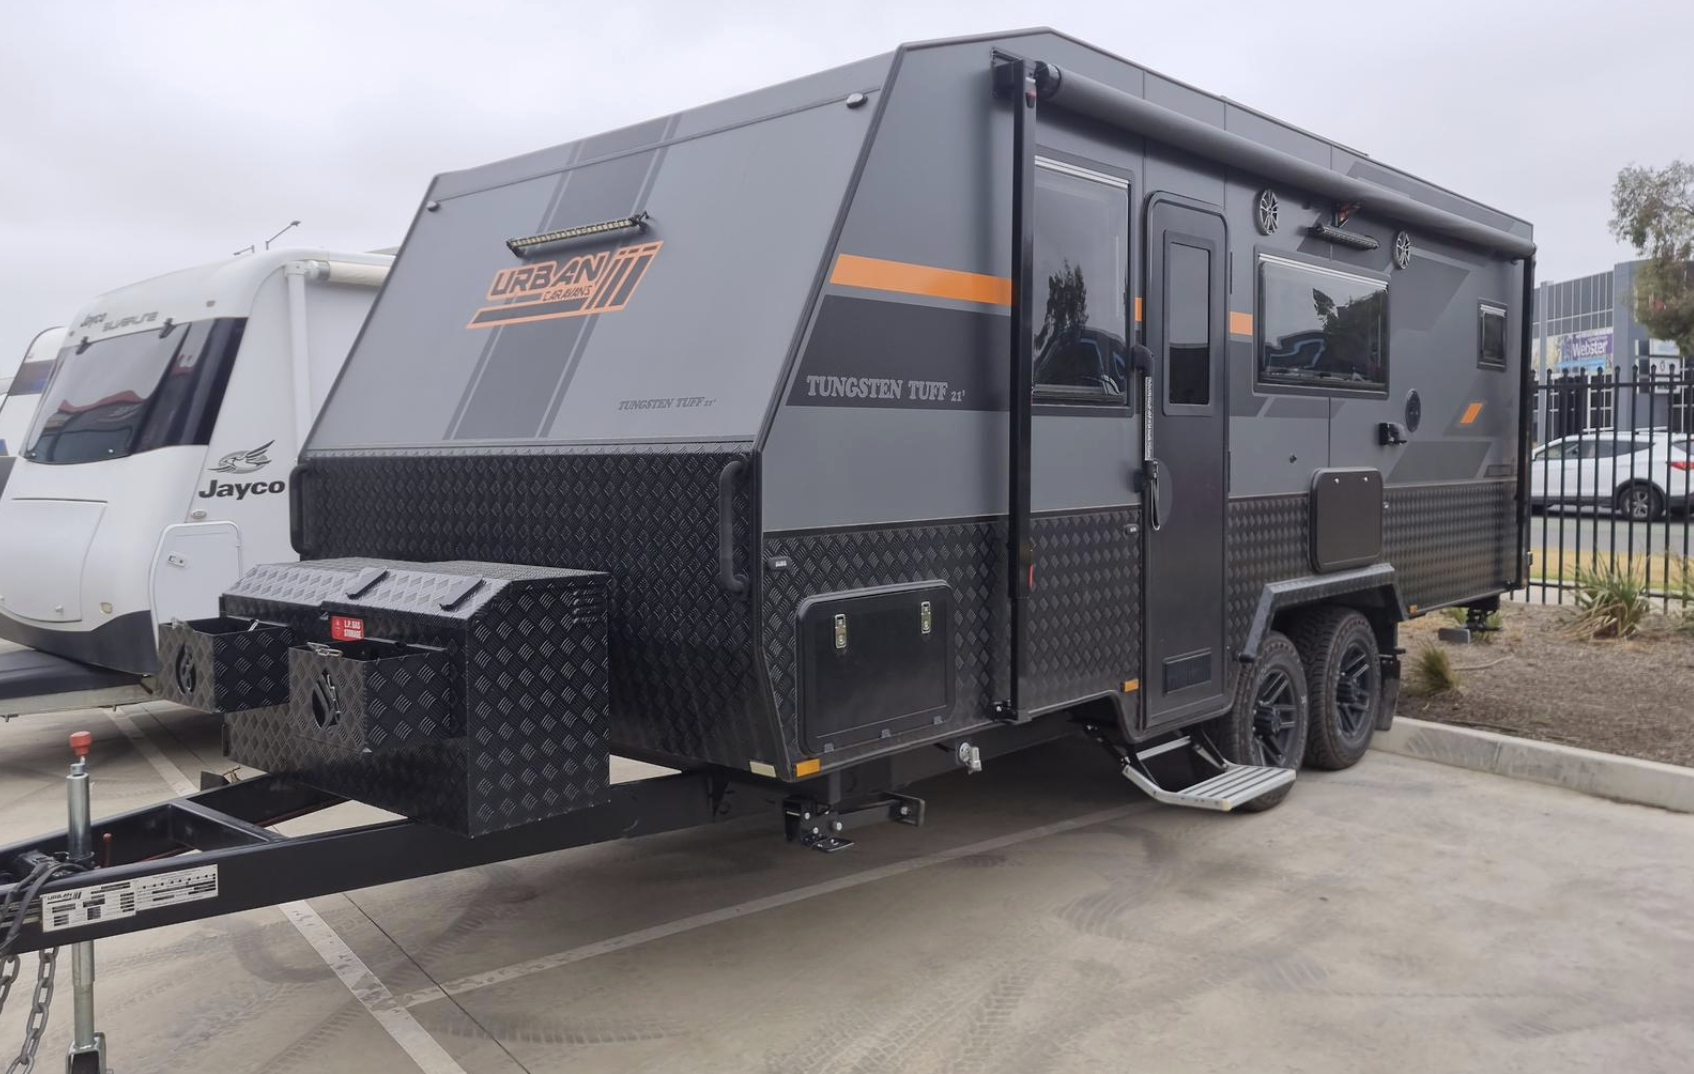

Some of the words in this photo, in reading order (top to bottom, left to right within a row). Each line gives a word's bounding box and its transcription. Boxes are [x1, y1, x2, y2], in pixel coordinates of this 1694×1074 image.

[489, 251, 610, 298] URBAN
[542, 284, 593, 302] CARAVANS
[1572, 340, 1607, 358] Webster
[806, 375, 903, 399] TUNGSTEN
[907, 380, 948, 401] TUFF
[618, 398, 675, 411] TUNGSTEN
[675, 396, 705, 408] TUFF
[198, 479, 286, 501] Jayco
